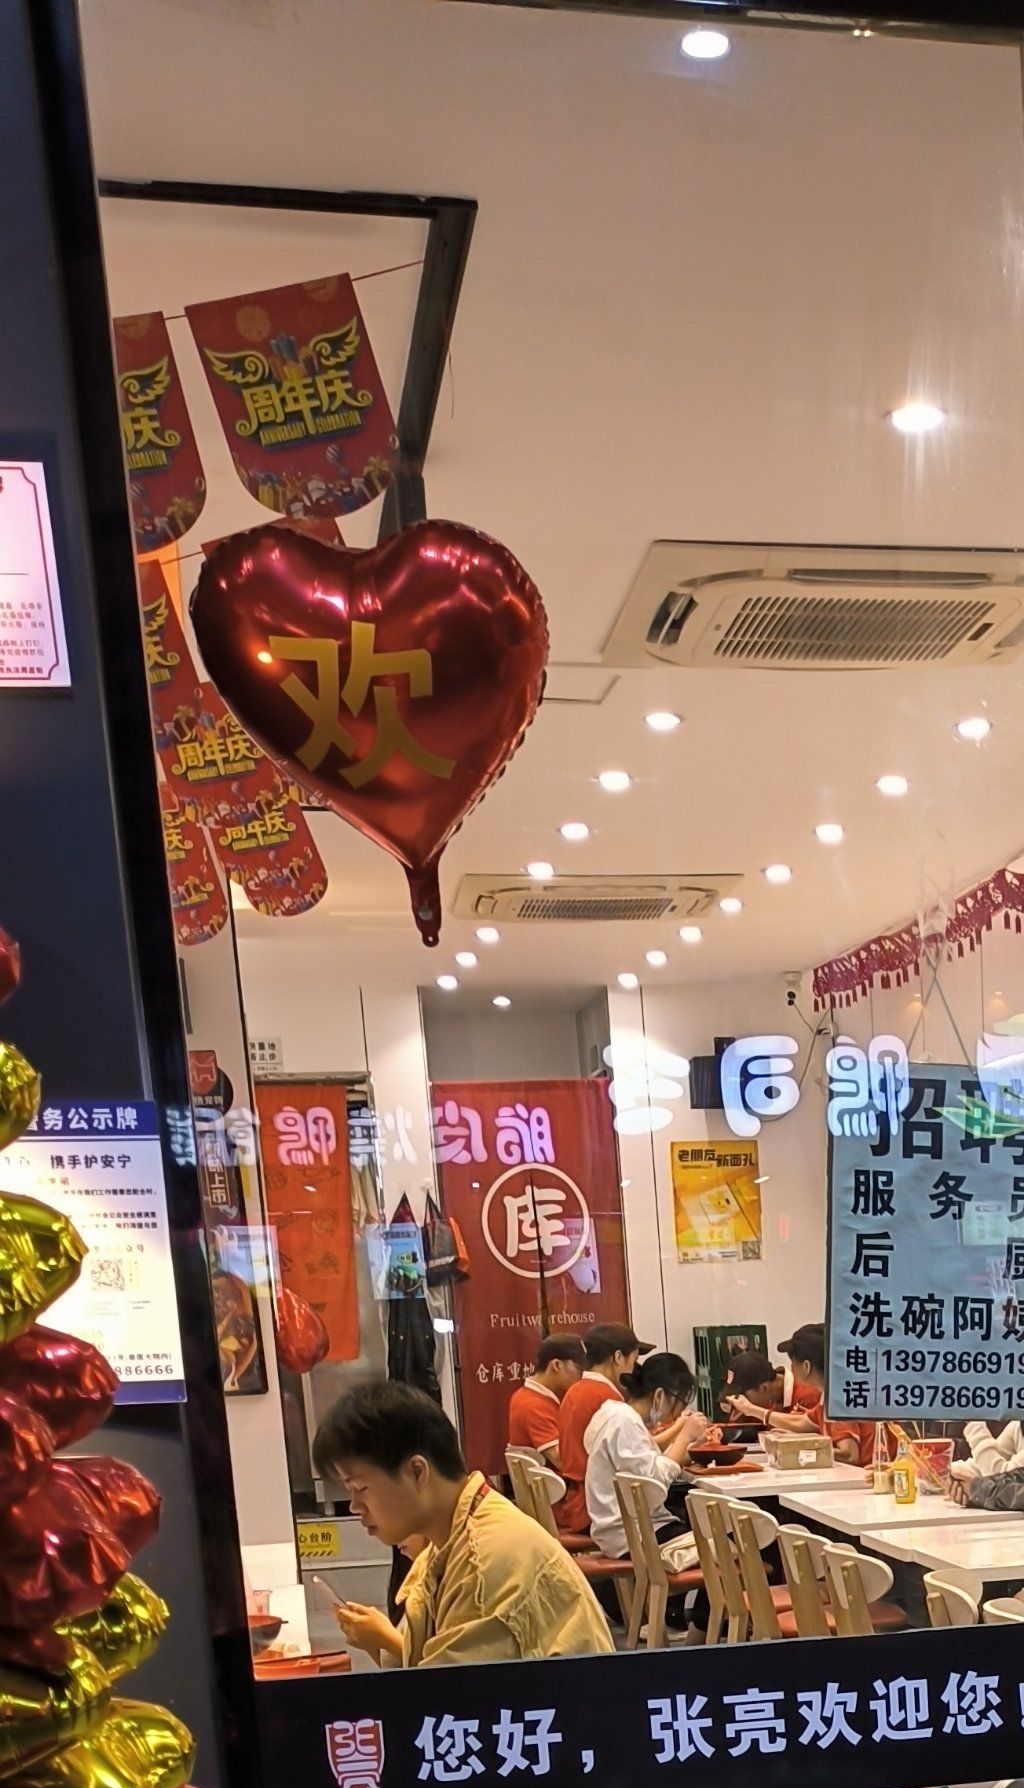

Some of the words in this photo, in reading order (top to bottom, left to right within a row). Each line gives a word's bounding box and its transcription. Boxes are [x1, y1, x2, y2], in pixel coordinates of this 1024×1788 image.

[235, 369, 374, 437] 周年庆
[269, 620, 457, 789] 欢
[171, 733, 265, 776] 周年庆
[27, 1107, 138, 1131] 务公示牌
[51, 1155, 132, 1170] 携手护安宁
[678, 1149, 718, 1162] 老朋友
[716, 1153, 755, 1167] 新面孔
[503, 1184, 571, 1258] 库
